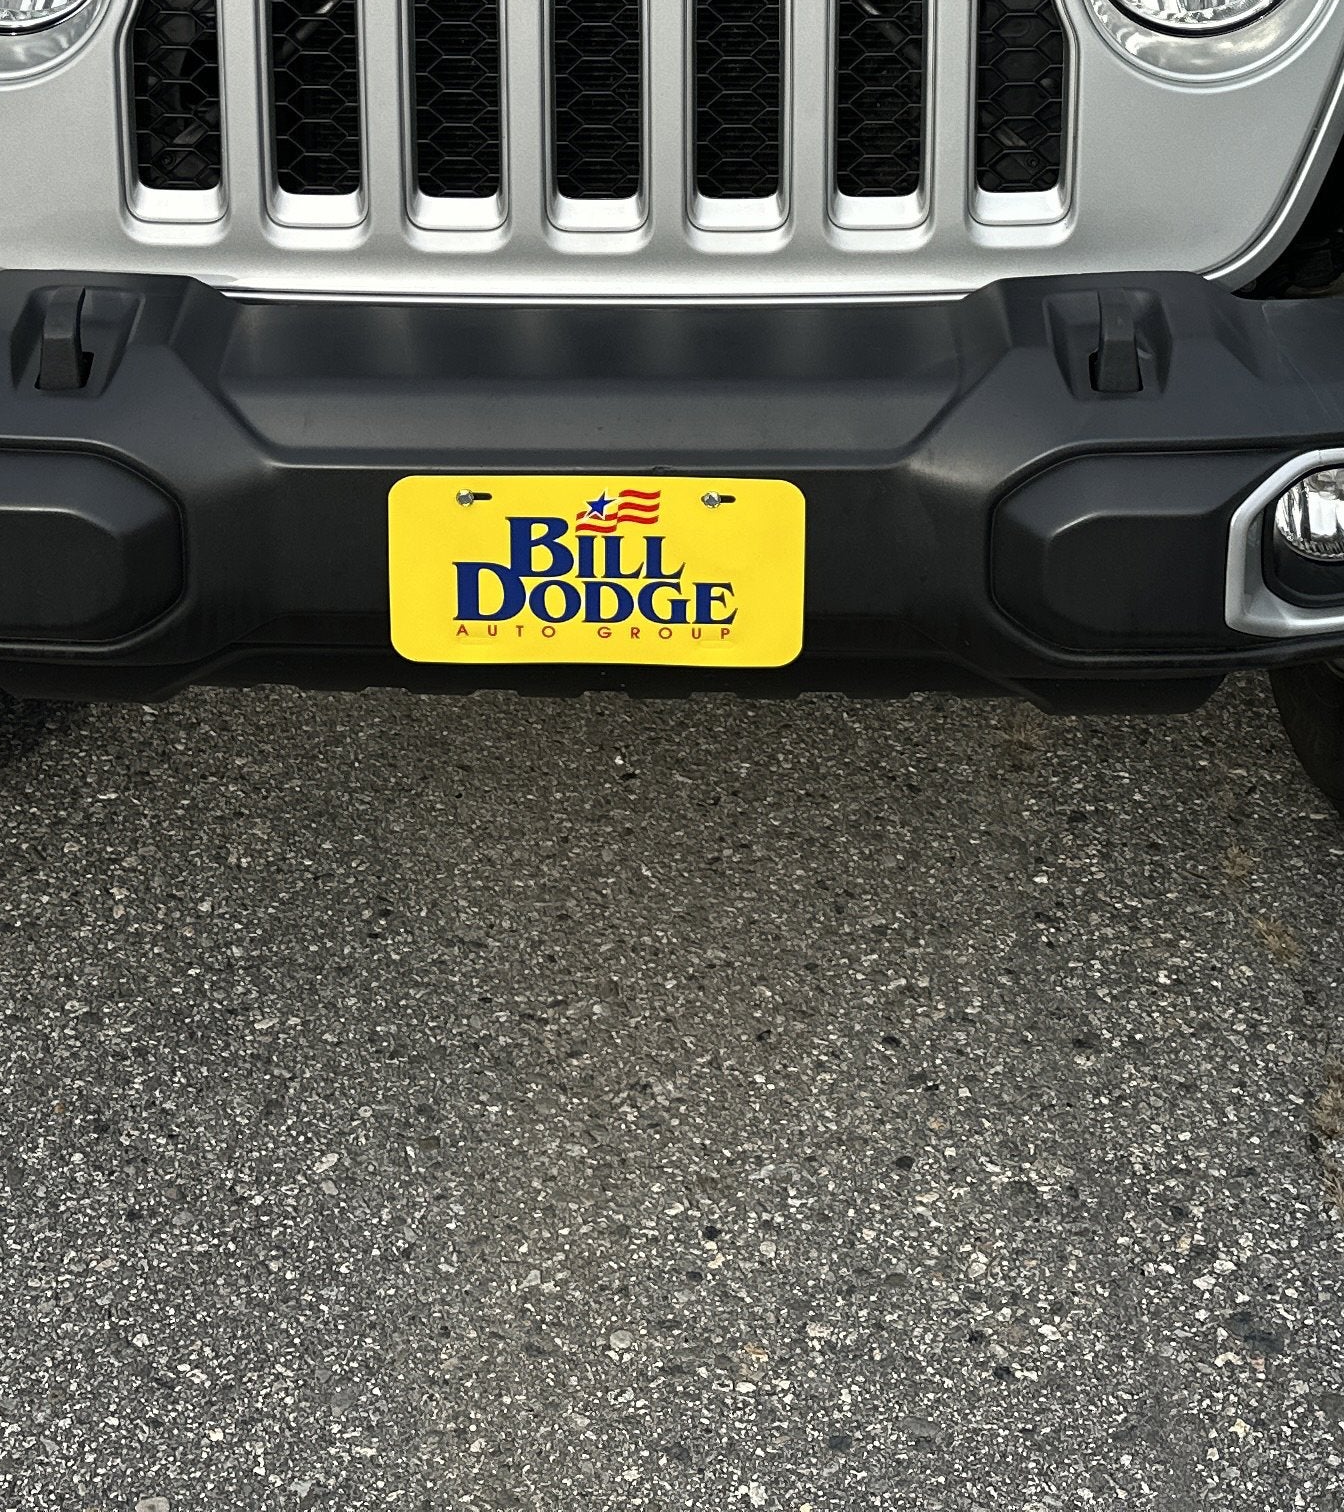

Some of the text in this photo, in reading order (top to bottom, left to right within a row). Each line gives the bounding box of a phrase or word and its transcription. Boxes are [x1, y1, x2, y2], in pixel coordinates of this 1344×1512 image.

[504, 516, 686, 579] BILL
[452, 561, 739, 625] DODGE
[455, 624, 732, 640] AUTO GROUP
